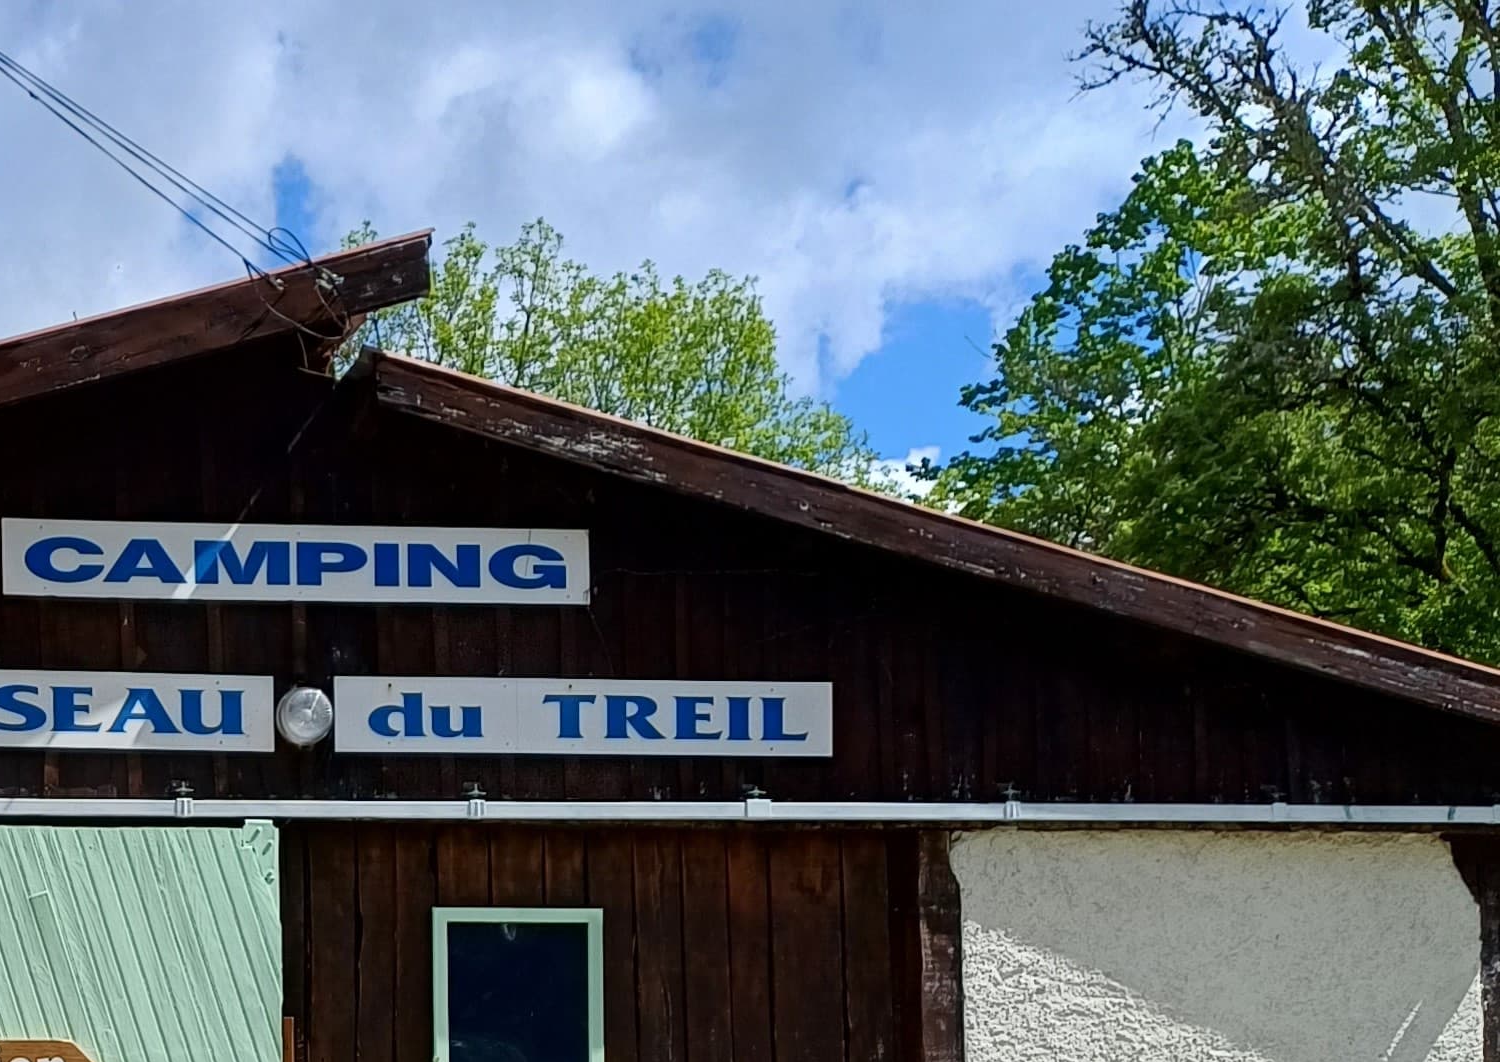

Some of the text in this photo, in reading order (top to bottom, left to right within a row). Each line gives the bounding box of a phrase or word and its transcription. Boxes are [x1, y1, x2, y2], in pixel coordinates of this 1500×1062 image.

[24, 536, 567, 590] CAMPING
[367, 692, 809, 742] du TREIL
